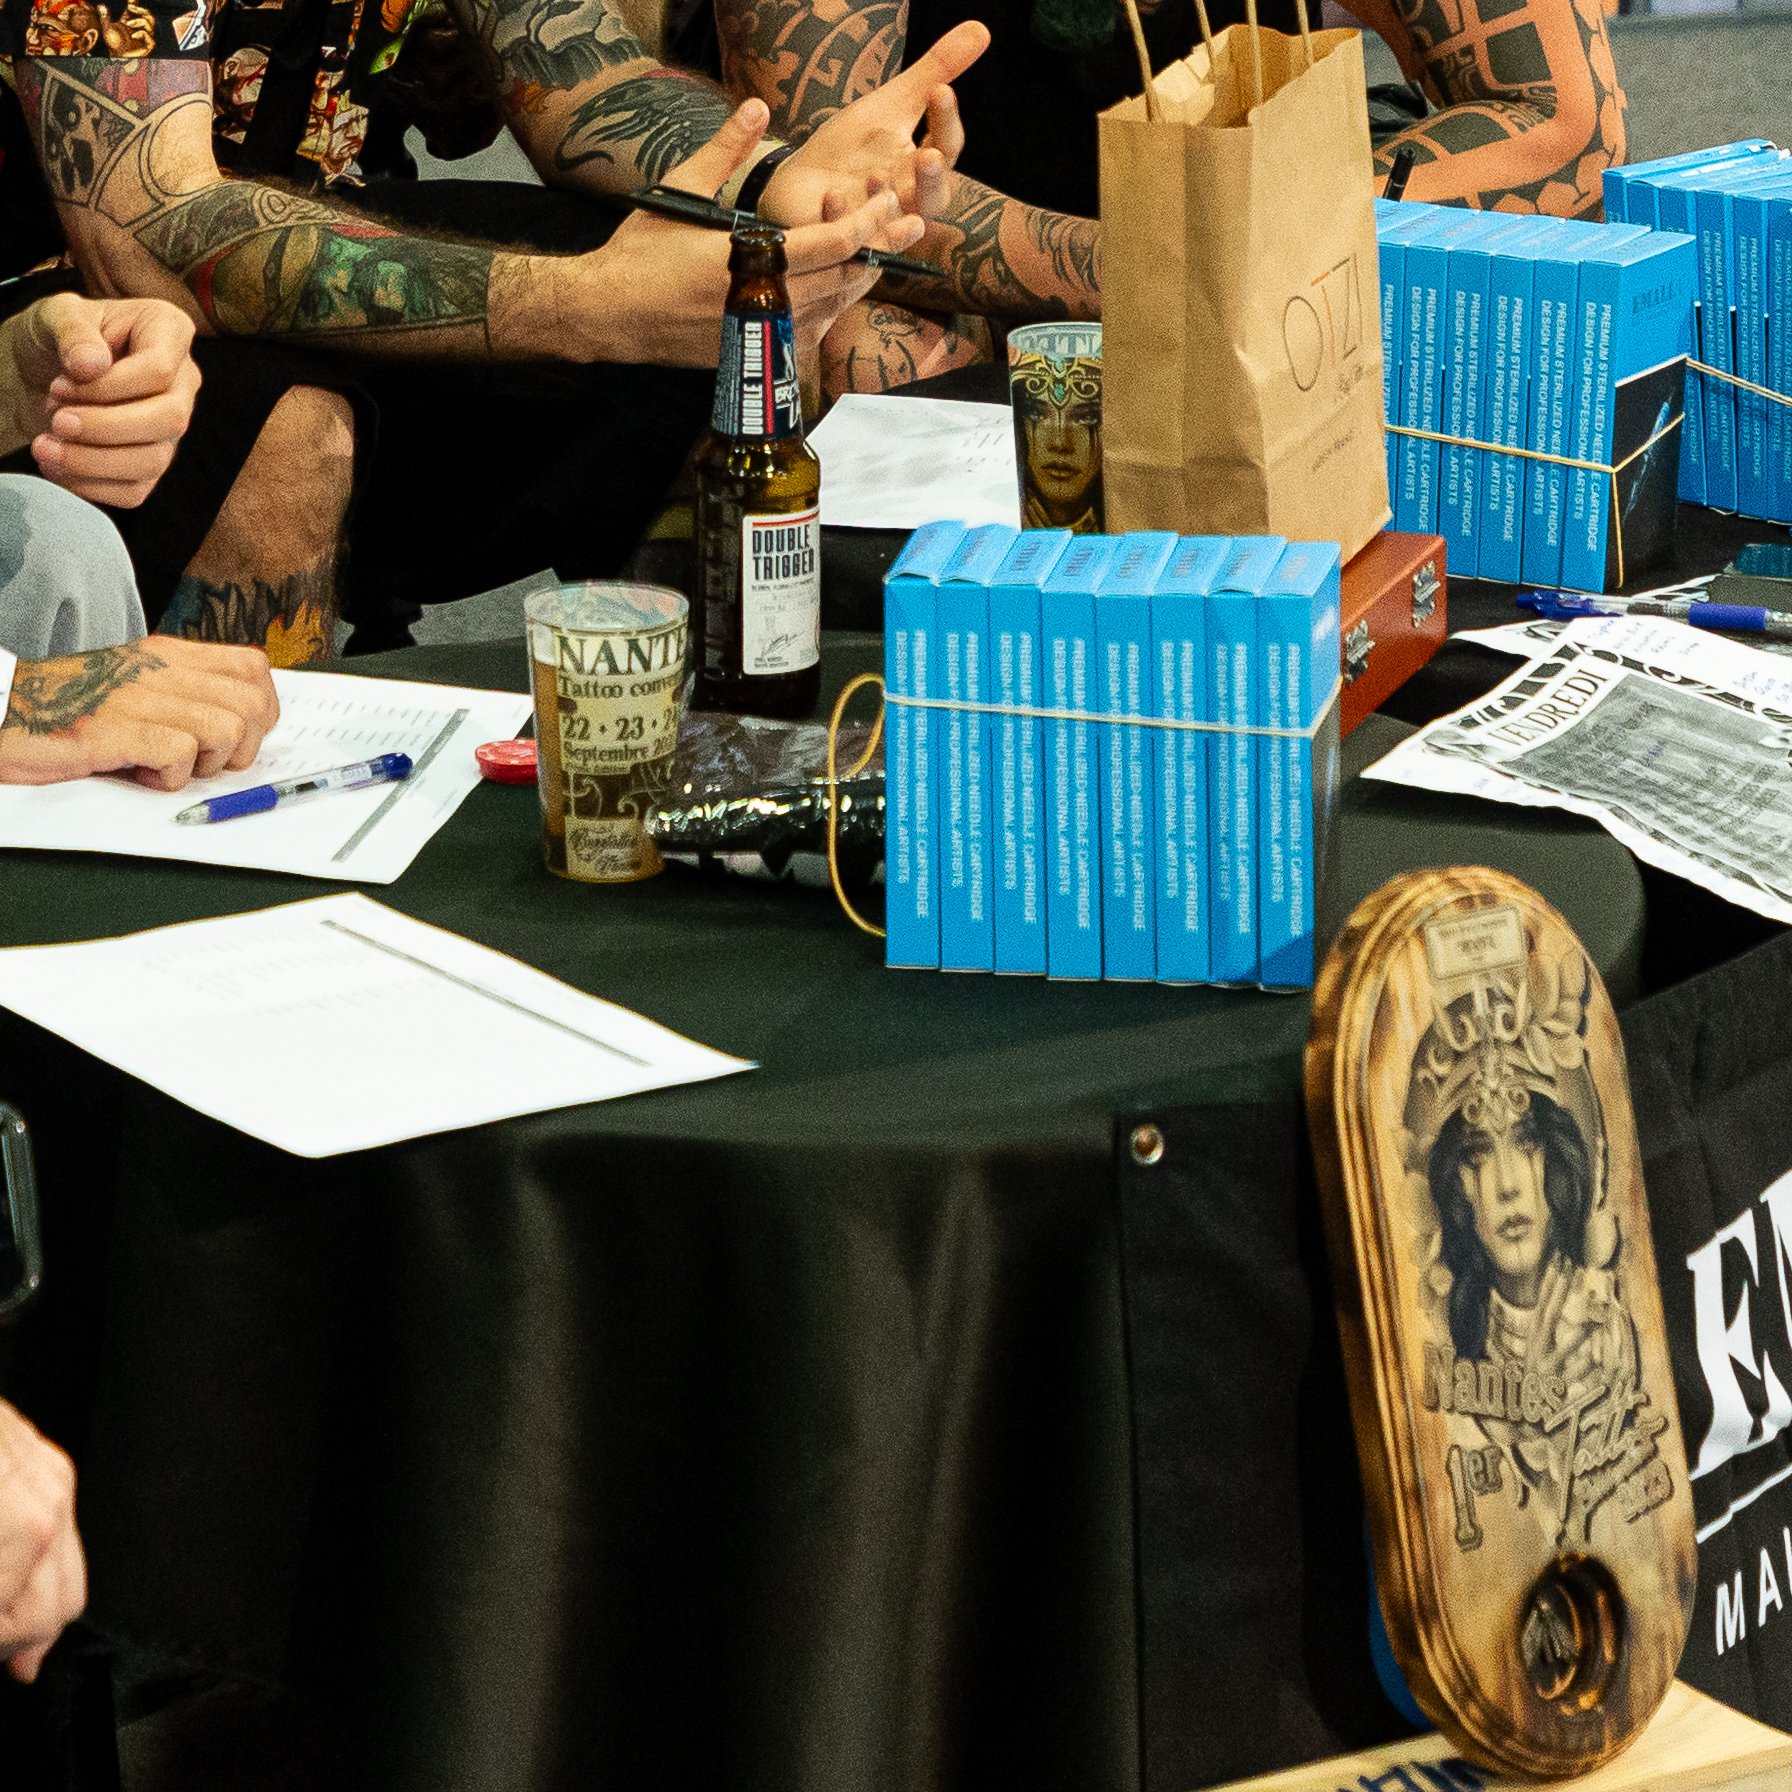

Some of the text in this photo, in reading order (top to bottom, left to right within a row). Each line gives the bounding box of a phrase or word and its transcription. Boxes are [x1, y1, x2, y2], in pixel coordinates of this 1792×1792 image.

[1411, 287, 1421, 331] DESIGN
[1425, 289, 1436, 343] PREMIUM
[1454, 291, 1465, 335] DESIGN
[1469, 293, 1480, 348] PREMIUM
[1496, 296, 1507, 340] DESIGN
[1511, 298, 1523, 353] PREMIUM
[1540, 300, 1551, 345] DESIGN
[1555, 303, 1567, 357] PREMIUM
[1584, 302, 1596, 347] DESIGN
[1598, 304, 1612, 359] PREMIUM
[1410, 334, 1420, 357] FOR
[1454, 338, 1464, 362] FOR
[1495, 343, 1506, 367] FOR
[1539, 348, 1549, 372] FOR
[1582, 350, 1593, 374] FOR
[742, 321, 764, 435] DOUBLE TRIGGER
[1422, 346, 1434, 412] STERILIZED
[1466, 351, 1478, 418] STERILIZED
[1508, 356, 1520, 423] STERILIZED
[1552, 361, 1564, 428] STERILIZED
[1594, 363, 1608, 430] STERILIZED
[1405, 452, 1416, 500] ARTISTS
[1418, 465, 1430, 531] CARTRIDGE
[1449, 457, 1460, 505] ARTISTS
[1489, 462, 1501, 510] ARTISTS
[1534, 467, 1545, 515] ARTISTS
[1574, 470, 1586, 519] ARTISTS
[1462, 469, 1474, 536] CARTRIDGE
[1503, 475, 1516, 541] CARTRIDGE
[1547, 480, 1560, 546] CARTRIDGE
[1587, 483, 1601, 551] CARTRIDGE
[752, 524, 810, 554] DOUBLE
[753, 548, 815, 580] TRIGGER
[558, 675, 623, 699] Tattoo
[1487, 669, 1608, 748] VENDREDI
[564, 740, 649, 765] Septembre
[615, 716, 645, 741] 23
